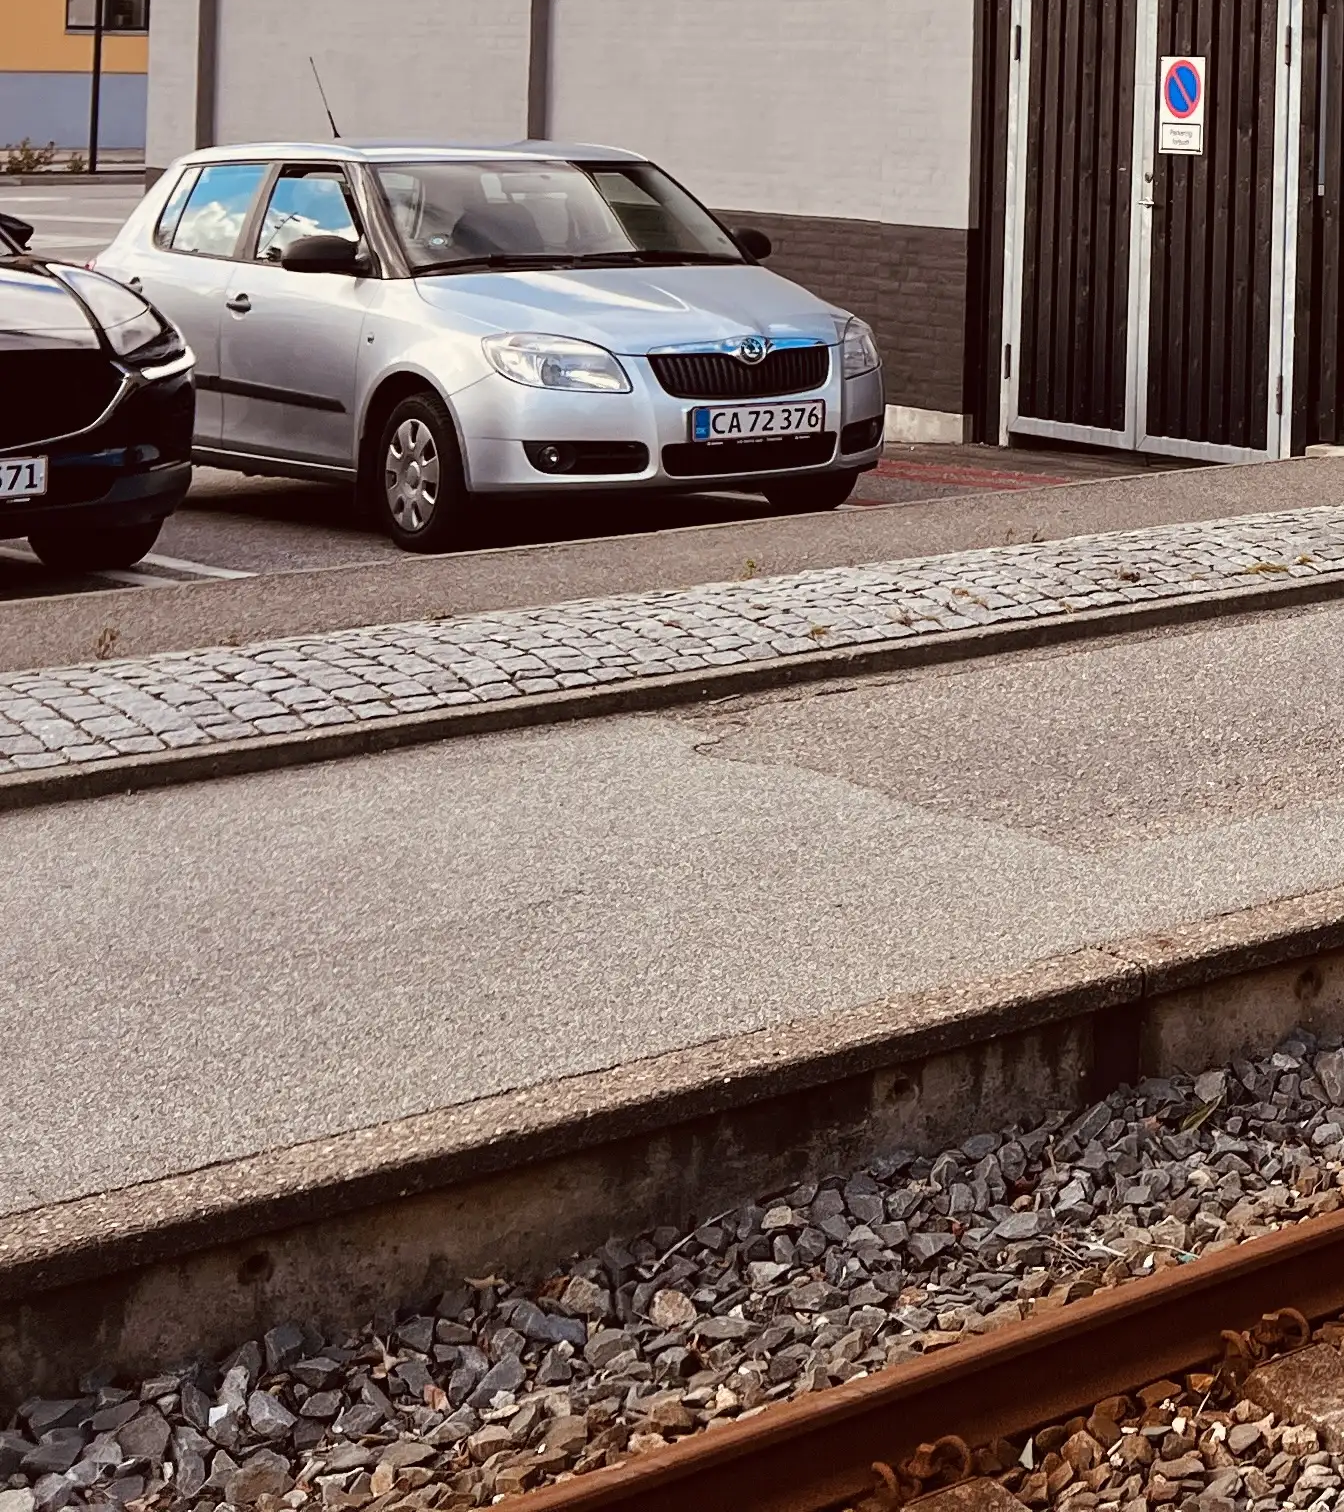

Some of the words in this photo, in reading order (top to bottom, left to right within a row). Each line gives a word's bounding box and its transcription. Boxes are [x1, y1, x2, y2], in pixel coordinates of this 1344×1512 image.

[711, 412, 742, 434] CA
[748, 409, 775, 432] 72
[779, 406, 819, 430] 376
[0, 463, 38, 491] 71
